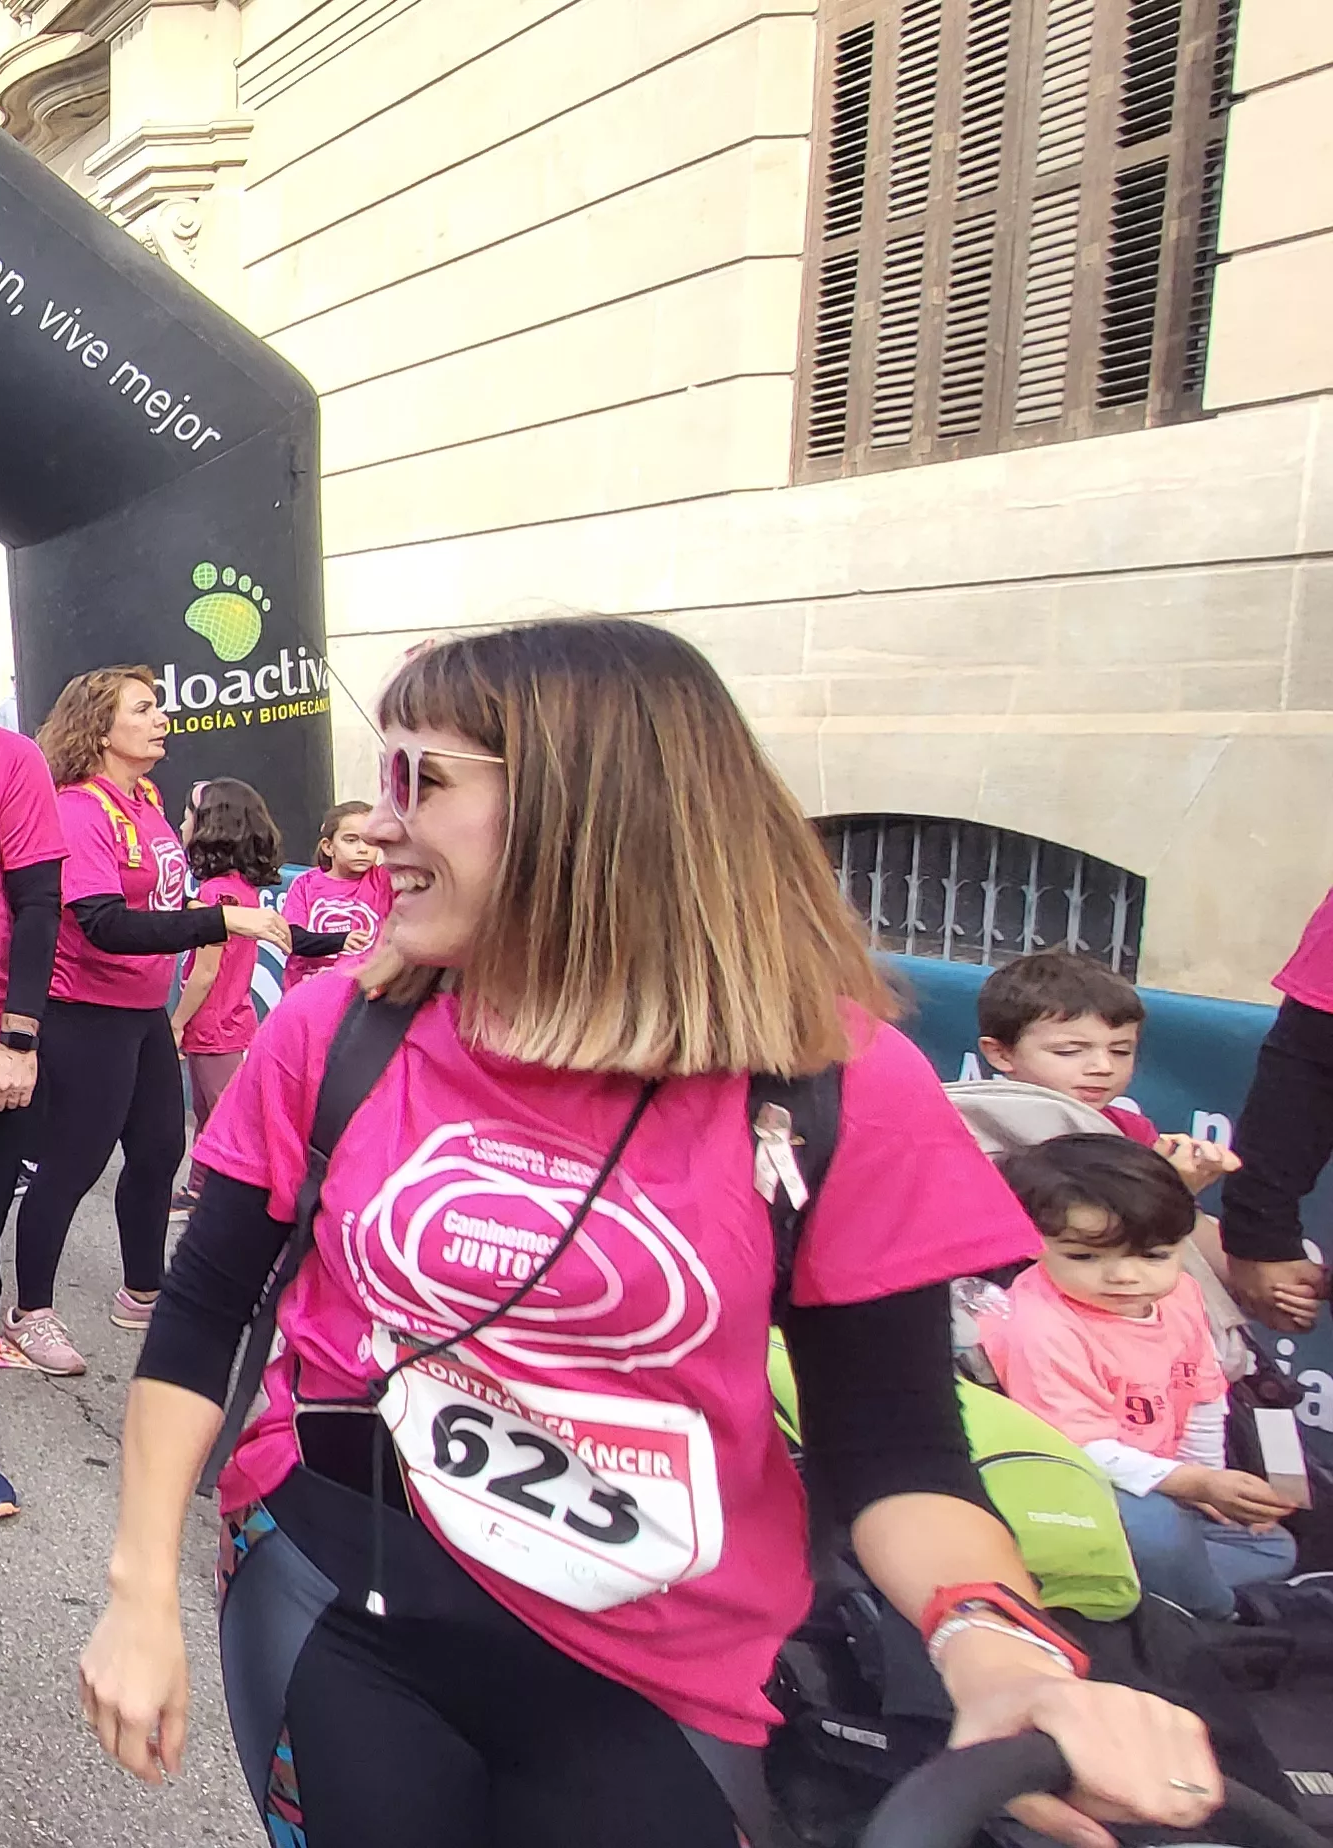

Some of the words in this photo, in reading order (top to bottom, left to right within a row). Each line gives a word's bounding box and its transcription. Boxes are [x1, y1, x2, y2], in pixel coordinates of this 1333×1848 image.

[37, 298, 109, 370] vive
[109, 355, 222, 452] mejor
[241, 711, 254, 726] Y
[412, 1357, 522, 1417] CONTRA
[431, 1403, 640, 1544] 623
